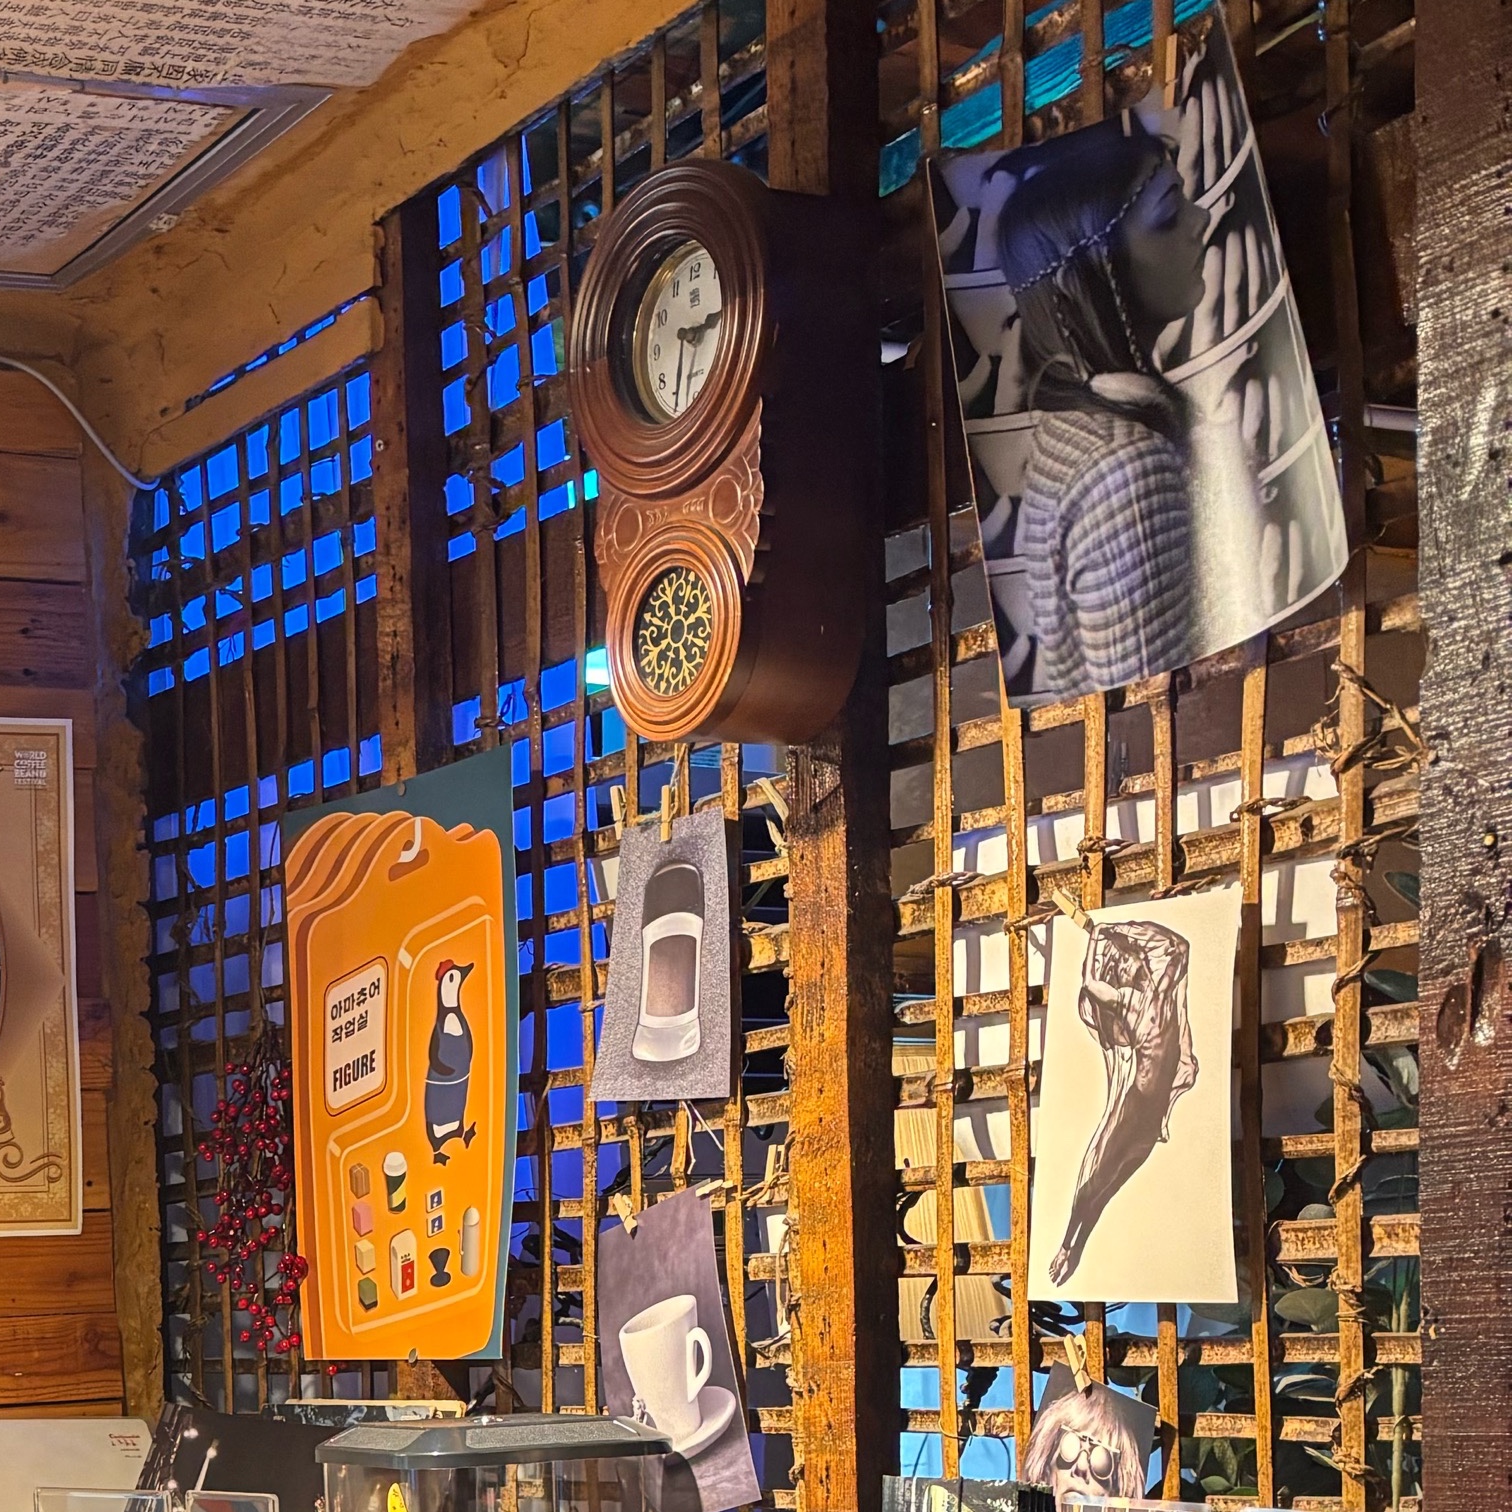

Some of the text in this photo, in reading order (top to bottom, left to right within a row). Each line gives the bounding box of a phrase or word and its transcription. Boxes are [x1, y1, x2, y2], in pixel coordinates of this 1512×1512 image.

[689, 262, 701, 282] 12
[672, 280, 680, 298] 11
[656, 309, 668, 328] 10
[653, 344, 661, 361] 9
[658, 372, 666, 390] 8
[330, 977, 381, 1021] 아마츄어
[331, 1010, 368, 1043] 작업실
[332, 1049, 376, 1092] FIGURE
